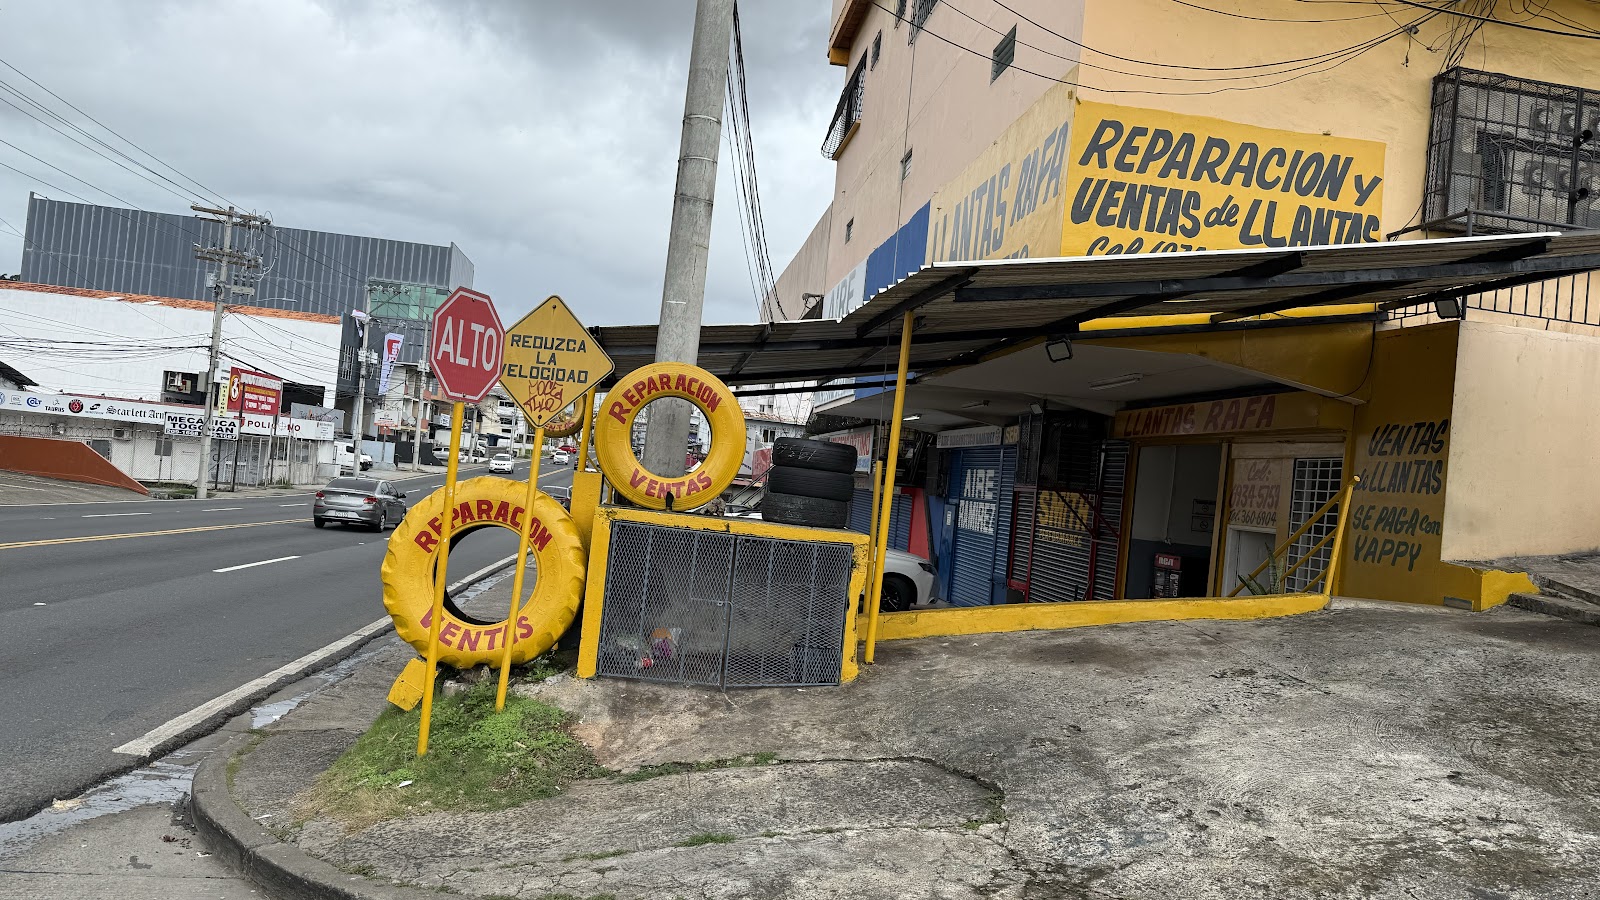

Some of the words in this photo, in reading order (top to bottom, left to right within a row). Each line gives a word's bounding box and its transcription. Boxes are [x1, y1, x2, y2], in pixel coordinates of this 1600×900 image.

[1009, 121, 1070, 229] RAFA
[1078, 118, 1354, 202] REPARACION
[1070, 177, 1202, 240] VENTAS
[1203, 195, 1240, 229] de
[1238, 199, 1382, 246] LLANTAS
[436, 316, 497, 372] ALTO
[510, 334, 587, 354] REDUZCA
[535, 351, 557, 366] LA
[44, 405, 65, 413] TAURUS
[105, 405, 146, 418] Scarlett
[608, 373, 723, 425] REPARACION
[1123, 405, 1196, 437] LLANTAS
[1203, 395, 1276, 432] RAFA
[544, 421, 576, 433] ENTAS
[1368, 418, 1449, 457] VENTAS
[629, 468, 713, 499] VENTAS
[963, 468, 995, 499] AIRE
[1368, 459, 1444, 495] LLANTAS
[413, 499, 553, 554] REPARACON
[1240, 509, 1277, 526] 360-6904
[1352, 504, 1376, 531] SE
[1373, 506, 1420, 537] PAGA
[1158, 556, 1174, 567] RCA
[1353, 534, 1422, 572] YAPPY
